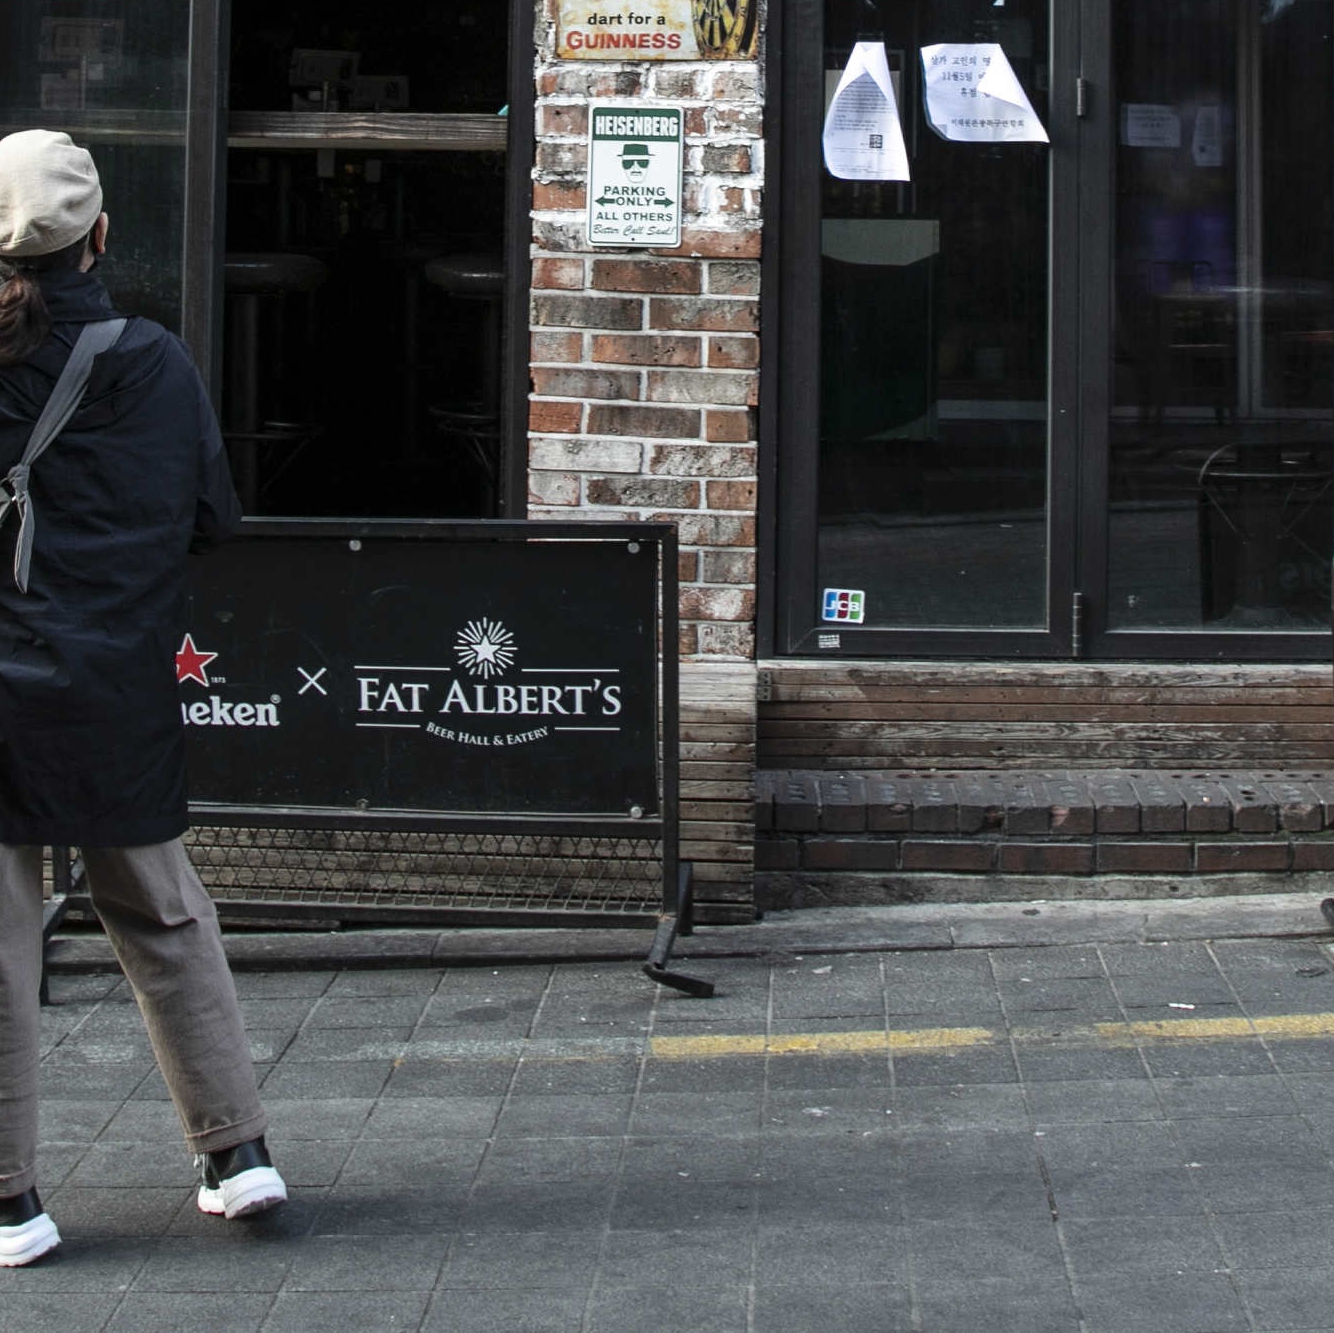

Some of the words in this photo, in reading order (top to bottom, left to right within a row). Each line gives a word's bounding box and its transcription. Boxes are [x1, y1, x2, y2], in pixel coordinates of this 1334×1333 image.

[587, 11, 622, 26] dart
[628, 11, 651, 26] for
[656, 14, 666, 25] a
[566, 30, 681, 51] GUINNESS
[595, 115, 679, 137] HEISENBERG
[603, 186, 666, 198] PARKING
[616, 196, 653, 208] ONLY
[596, 212, 620, 222] ALL
[623, 211, 673, 223] OTHERS
[593, 223, 622, 236] Better
[623, 223, 645, 237] Call
[356, 677, 430, 713] FAT
[439, 677, 623, 717] ALBERT'S
[426, 721, 456, 741] BEER
[458, 730, 490, 745] HALL
[492, 734, 504, 746] &
[506, 725, 550, 746] EATERY
